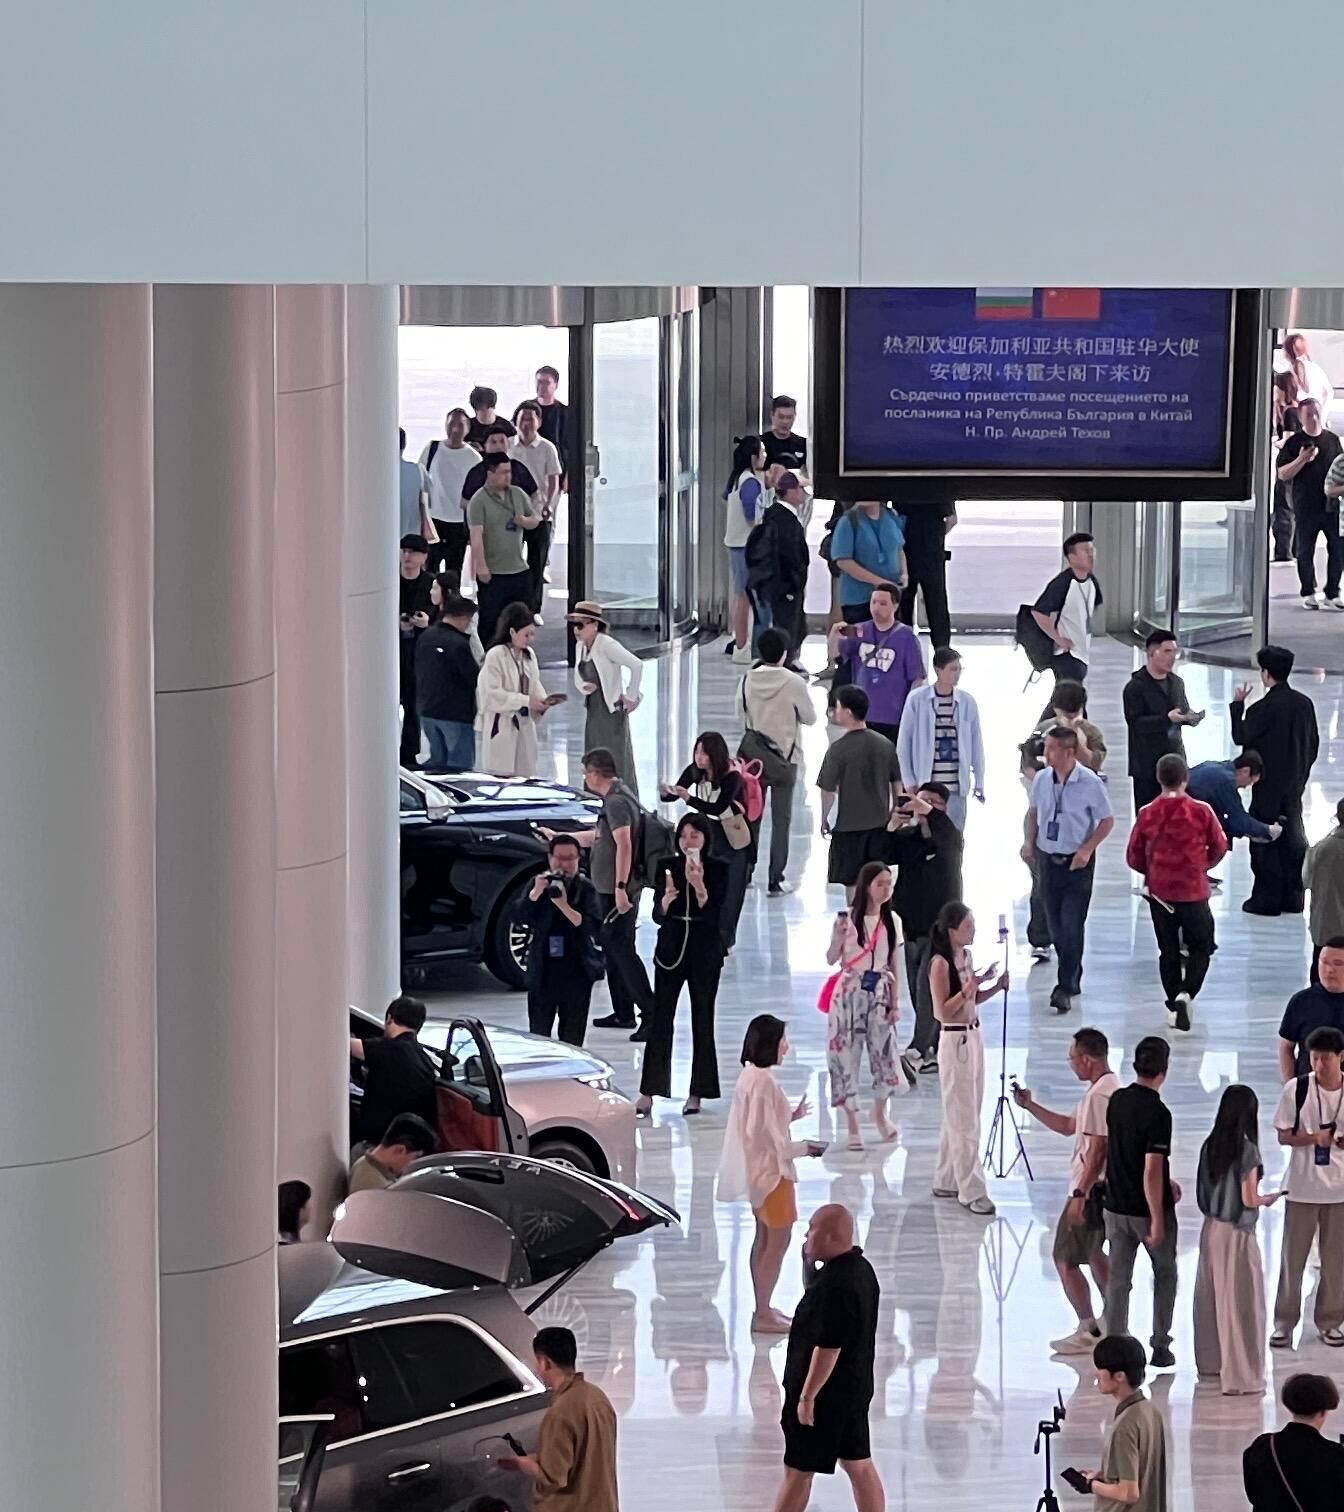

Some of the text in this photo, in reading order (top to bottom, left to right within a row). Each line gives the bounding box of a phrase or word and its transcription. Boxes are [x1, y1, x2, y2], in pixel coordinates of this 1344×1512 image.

[883, 335, 1200, 357] 热烈欢迎保加利亚共和国驻华大使
[929, 362, 1151, 383] 安德烈·特霍夫阁下来访
[890, 388, 1189, 405] Сърдечно приветстваме посещението на
[884, 407, 1193, 422] посланика на Република България в Китай
[1011, 426, 1067, 440] Андрей
[1071, 427, 1111, 439] Техов
